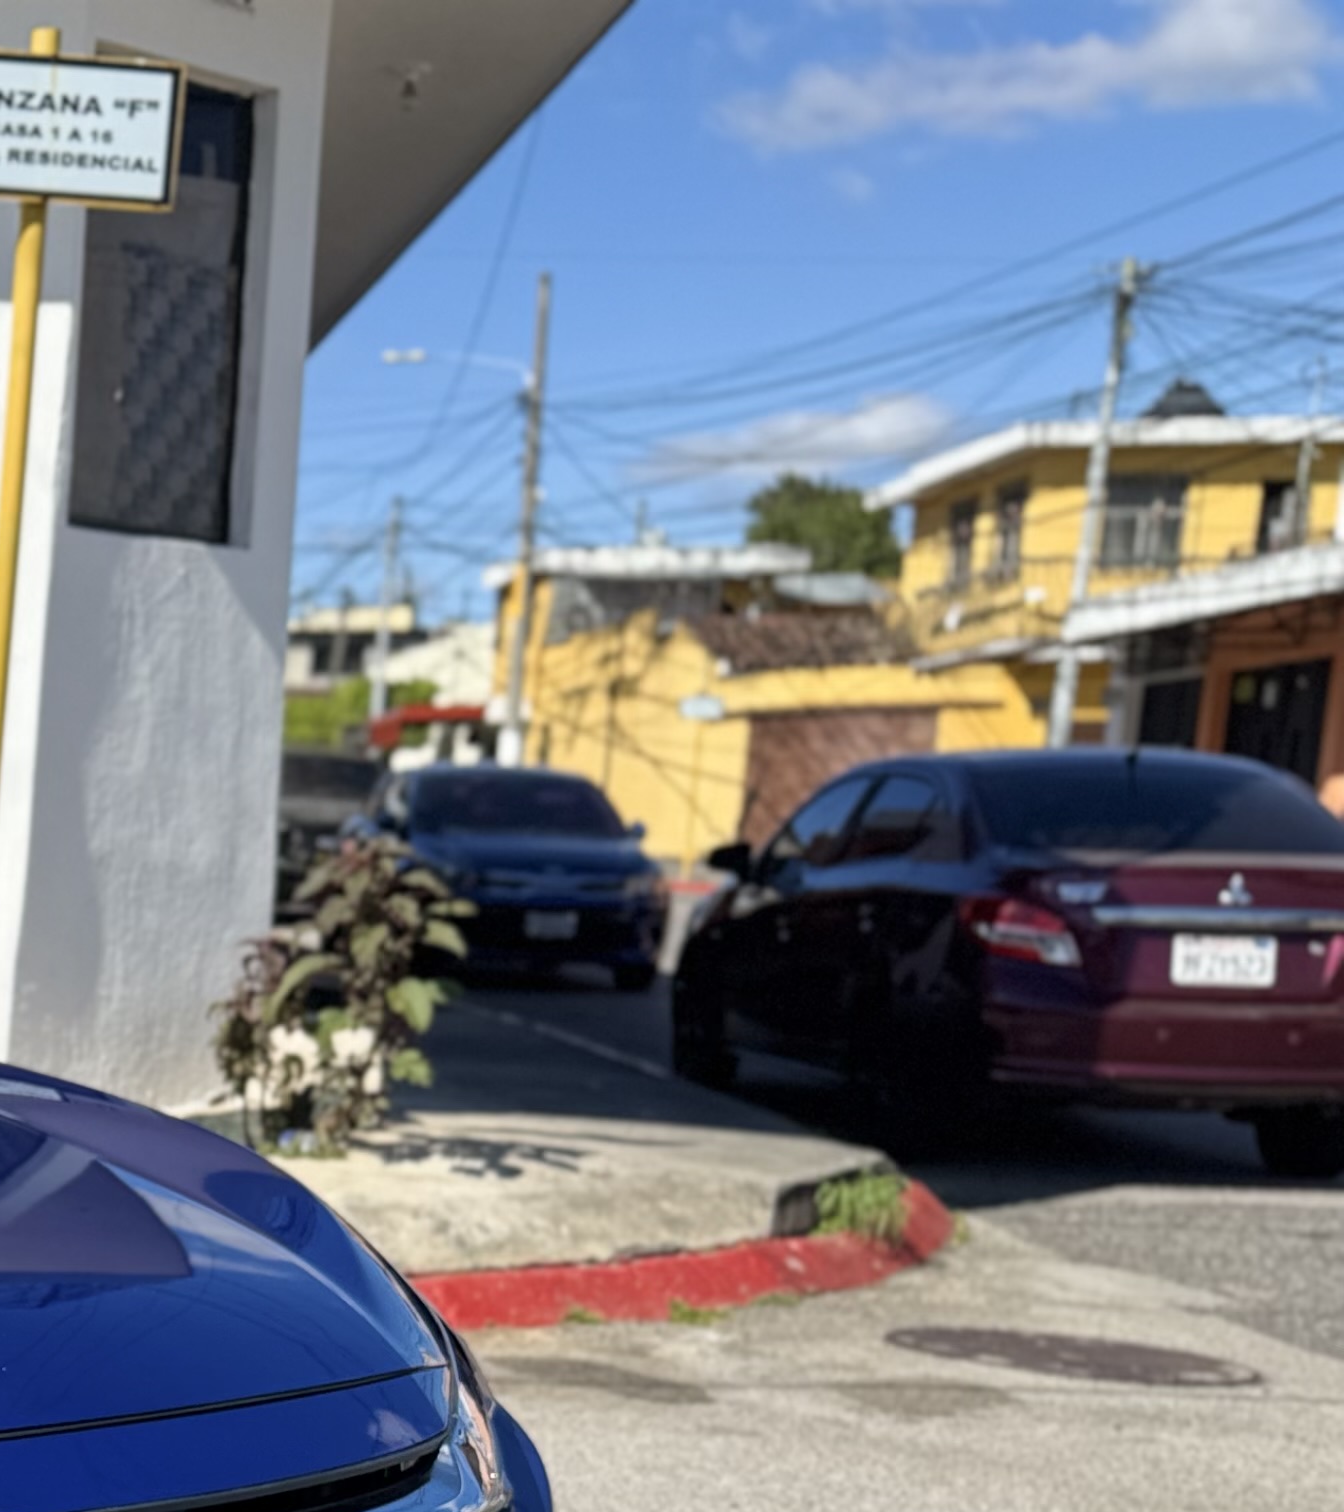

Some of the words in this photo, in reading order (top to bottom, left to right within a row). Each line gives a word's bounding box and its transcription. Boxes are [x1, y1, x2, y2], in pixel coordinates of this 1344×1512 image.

[51, 127, 60, 140] 1
[69, 128, 82, 142] A
[7, 148, 159, 174] RESIDENCIAL
